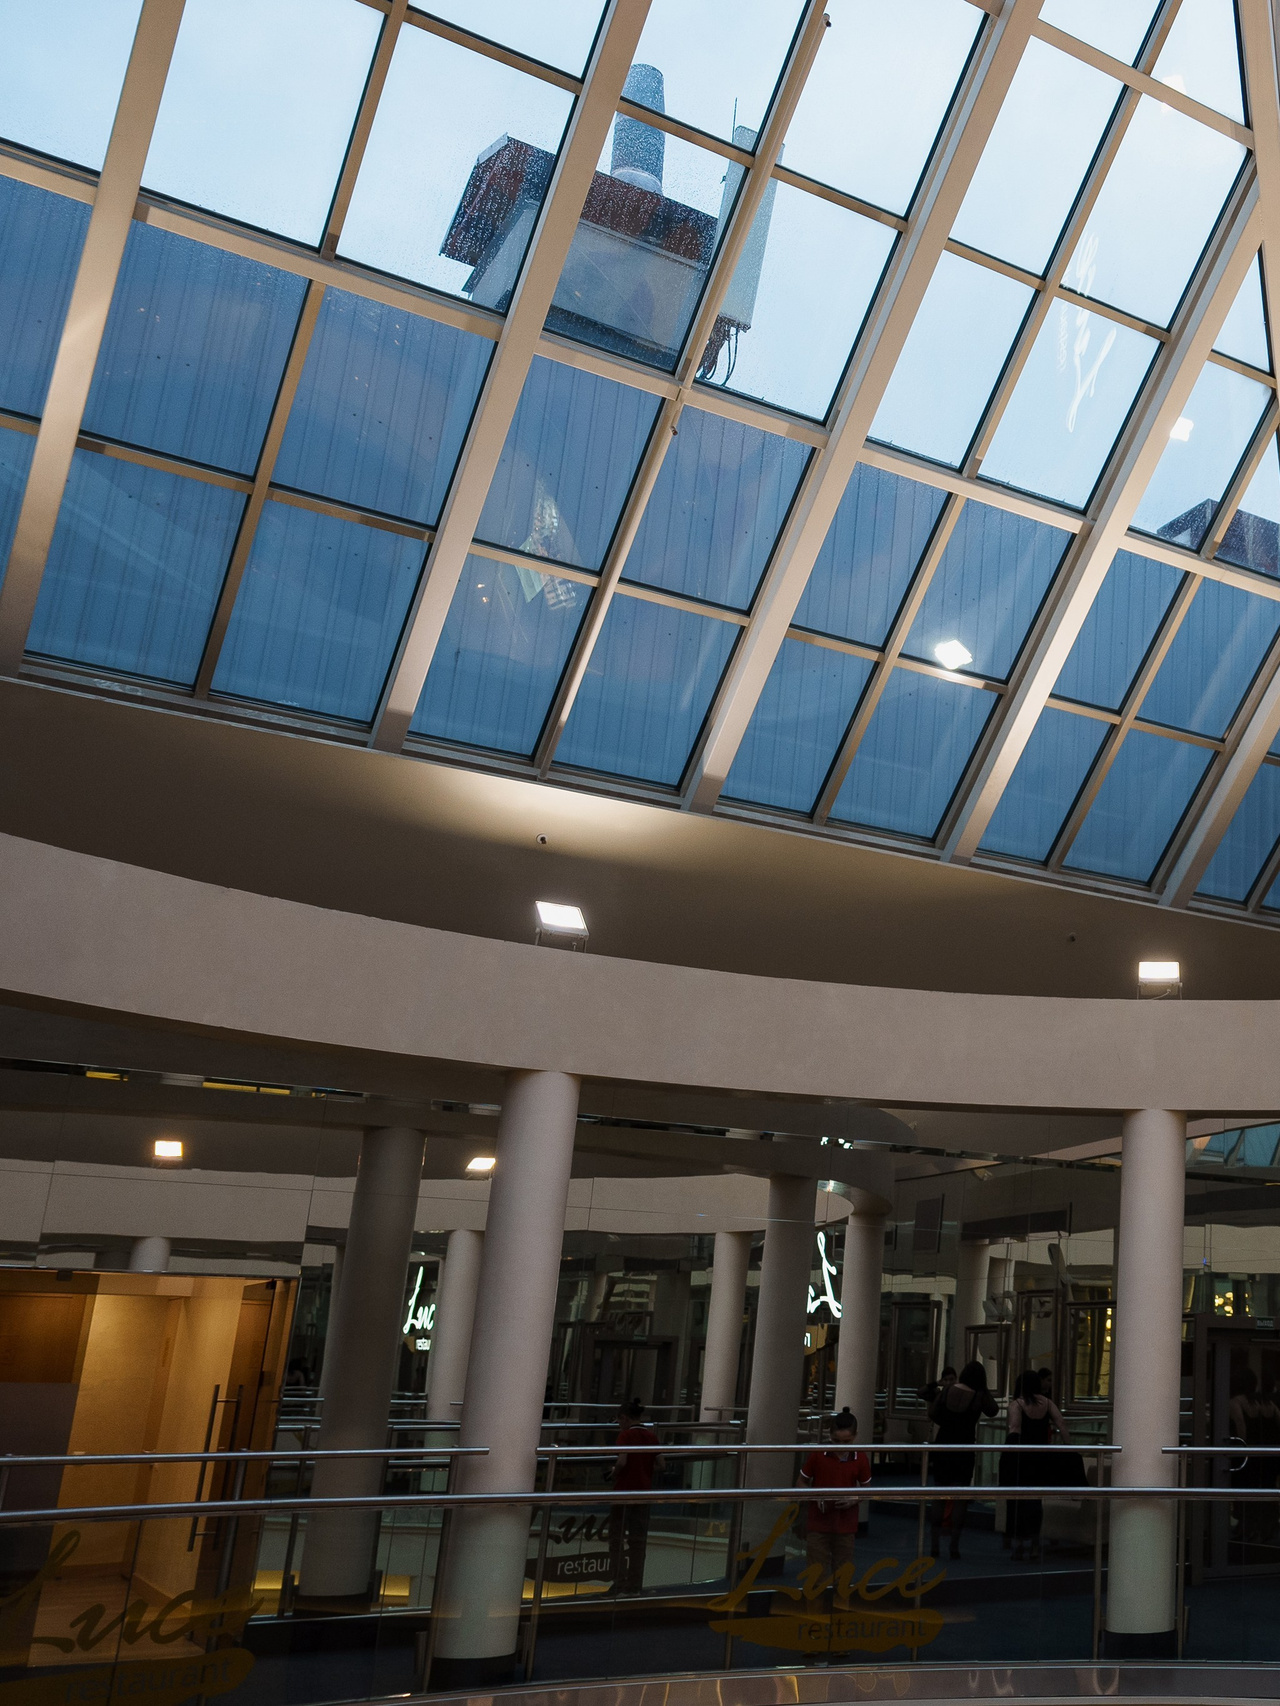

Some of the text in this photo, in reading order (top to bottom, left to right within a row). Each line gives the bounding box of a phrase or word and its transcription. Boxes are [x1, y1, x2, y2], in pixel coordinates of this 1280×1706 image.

[403, 1266, 436, 1334] Luc
[705, 1503, 947, 1612] Luce
[798, 1617, 926, 1641] restaurant
